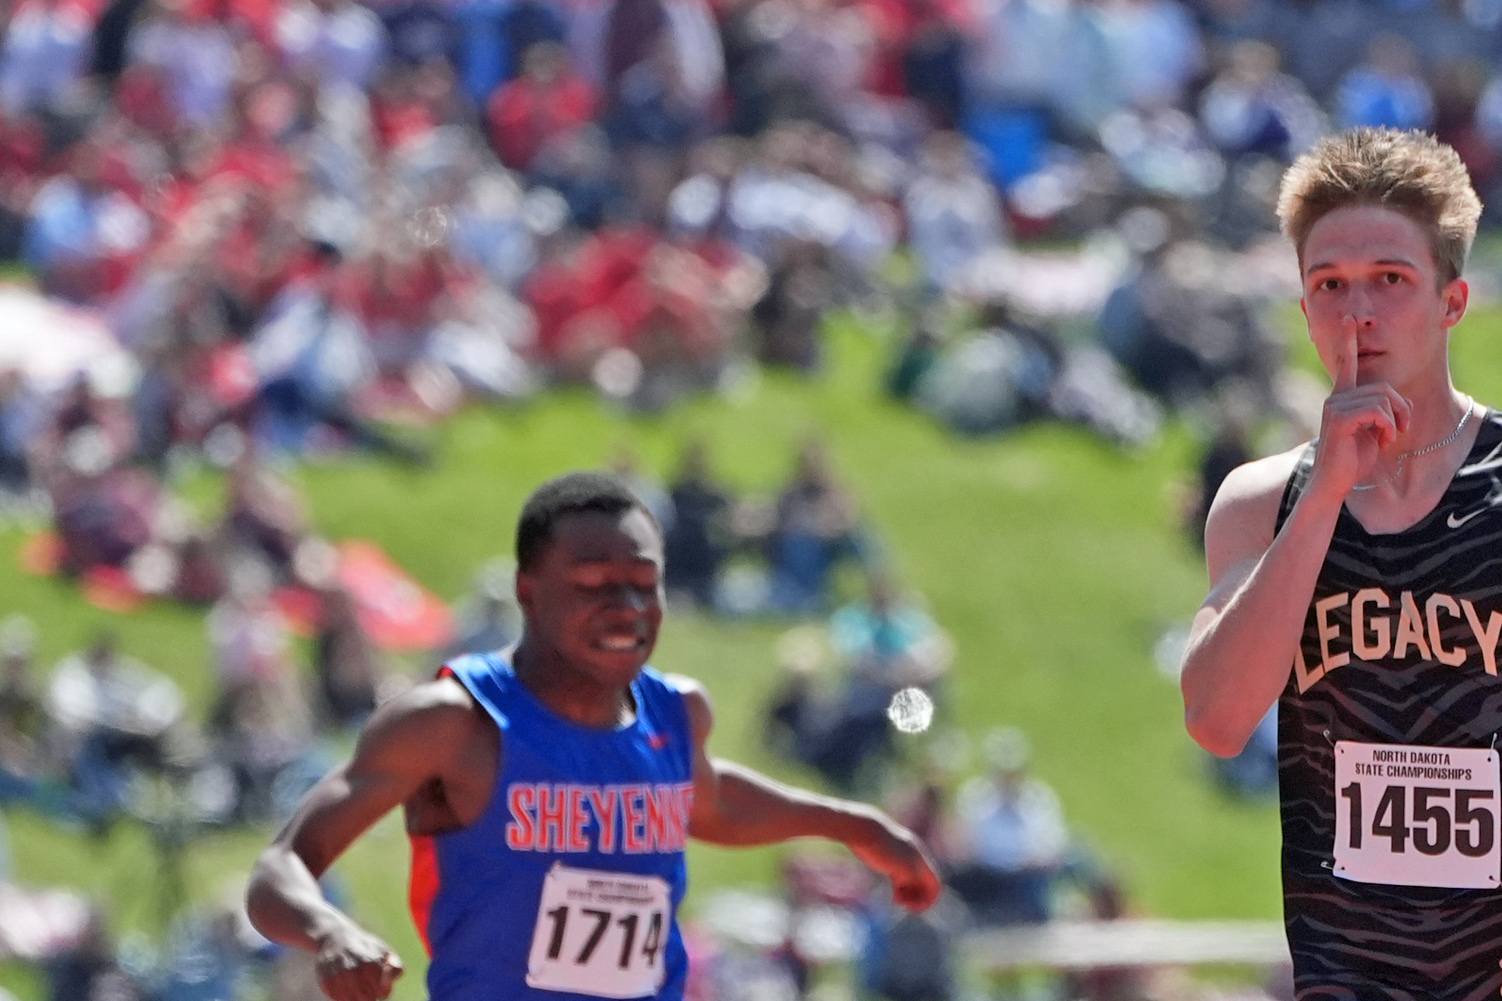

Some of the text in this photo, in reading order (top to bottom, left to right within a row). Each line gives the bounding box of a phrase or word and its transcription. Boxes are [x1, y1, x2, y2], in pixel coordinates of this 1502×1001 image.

[1355, 763, 1472, 780] STATE CHAMPIONSHIPS
[1373, 750, 1451, 765] NORTH DAKOTA
[1341, 782, 1495, 857] 1455
[547, 905, 663, 970] 1714
